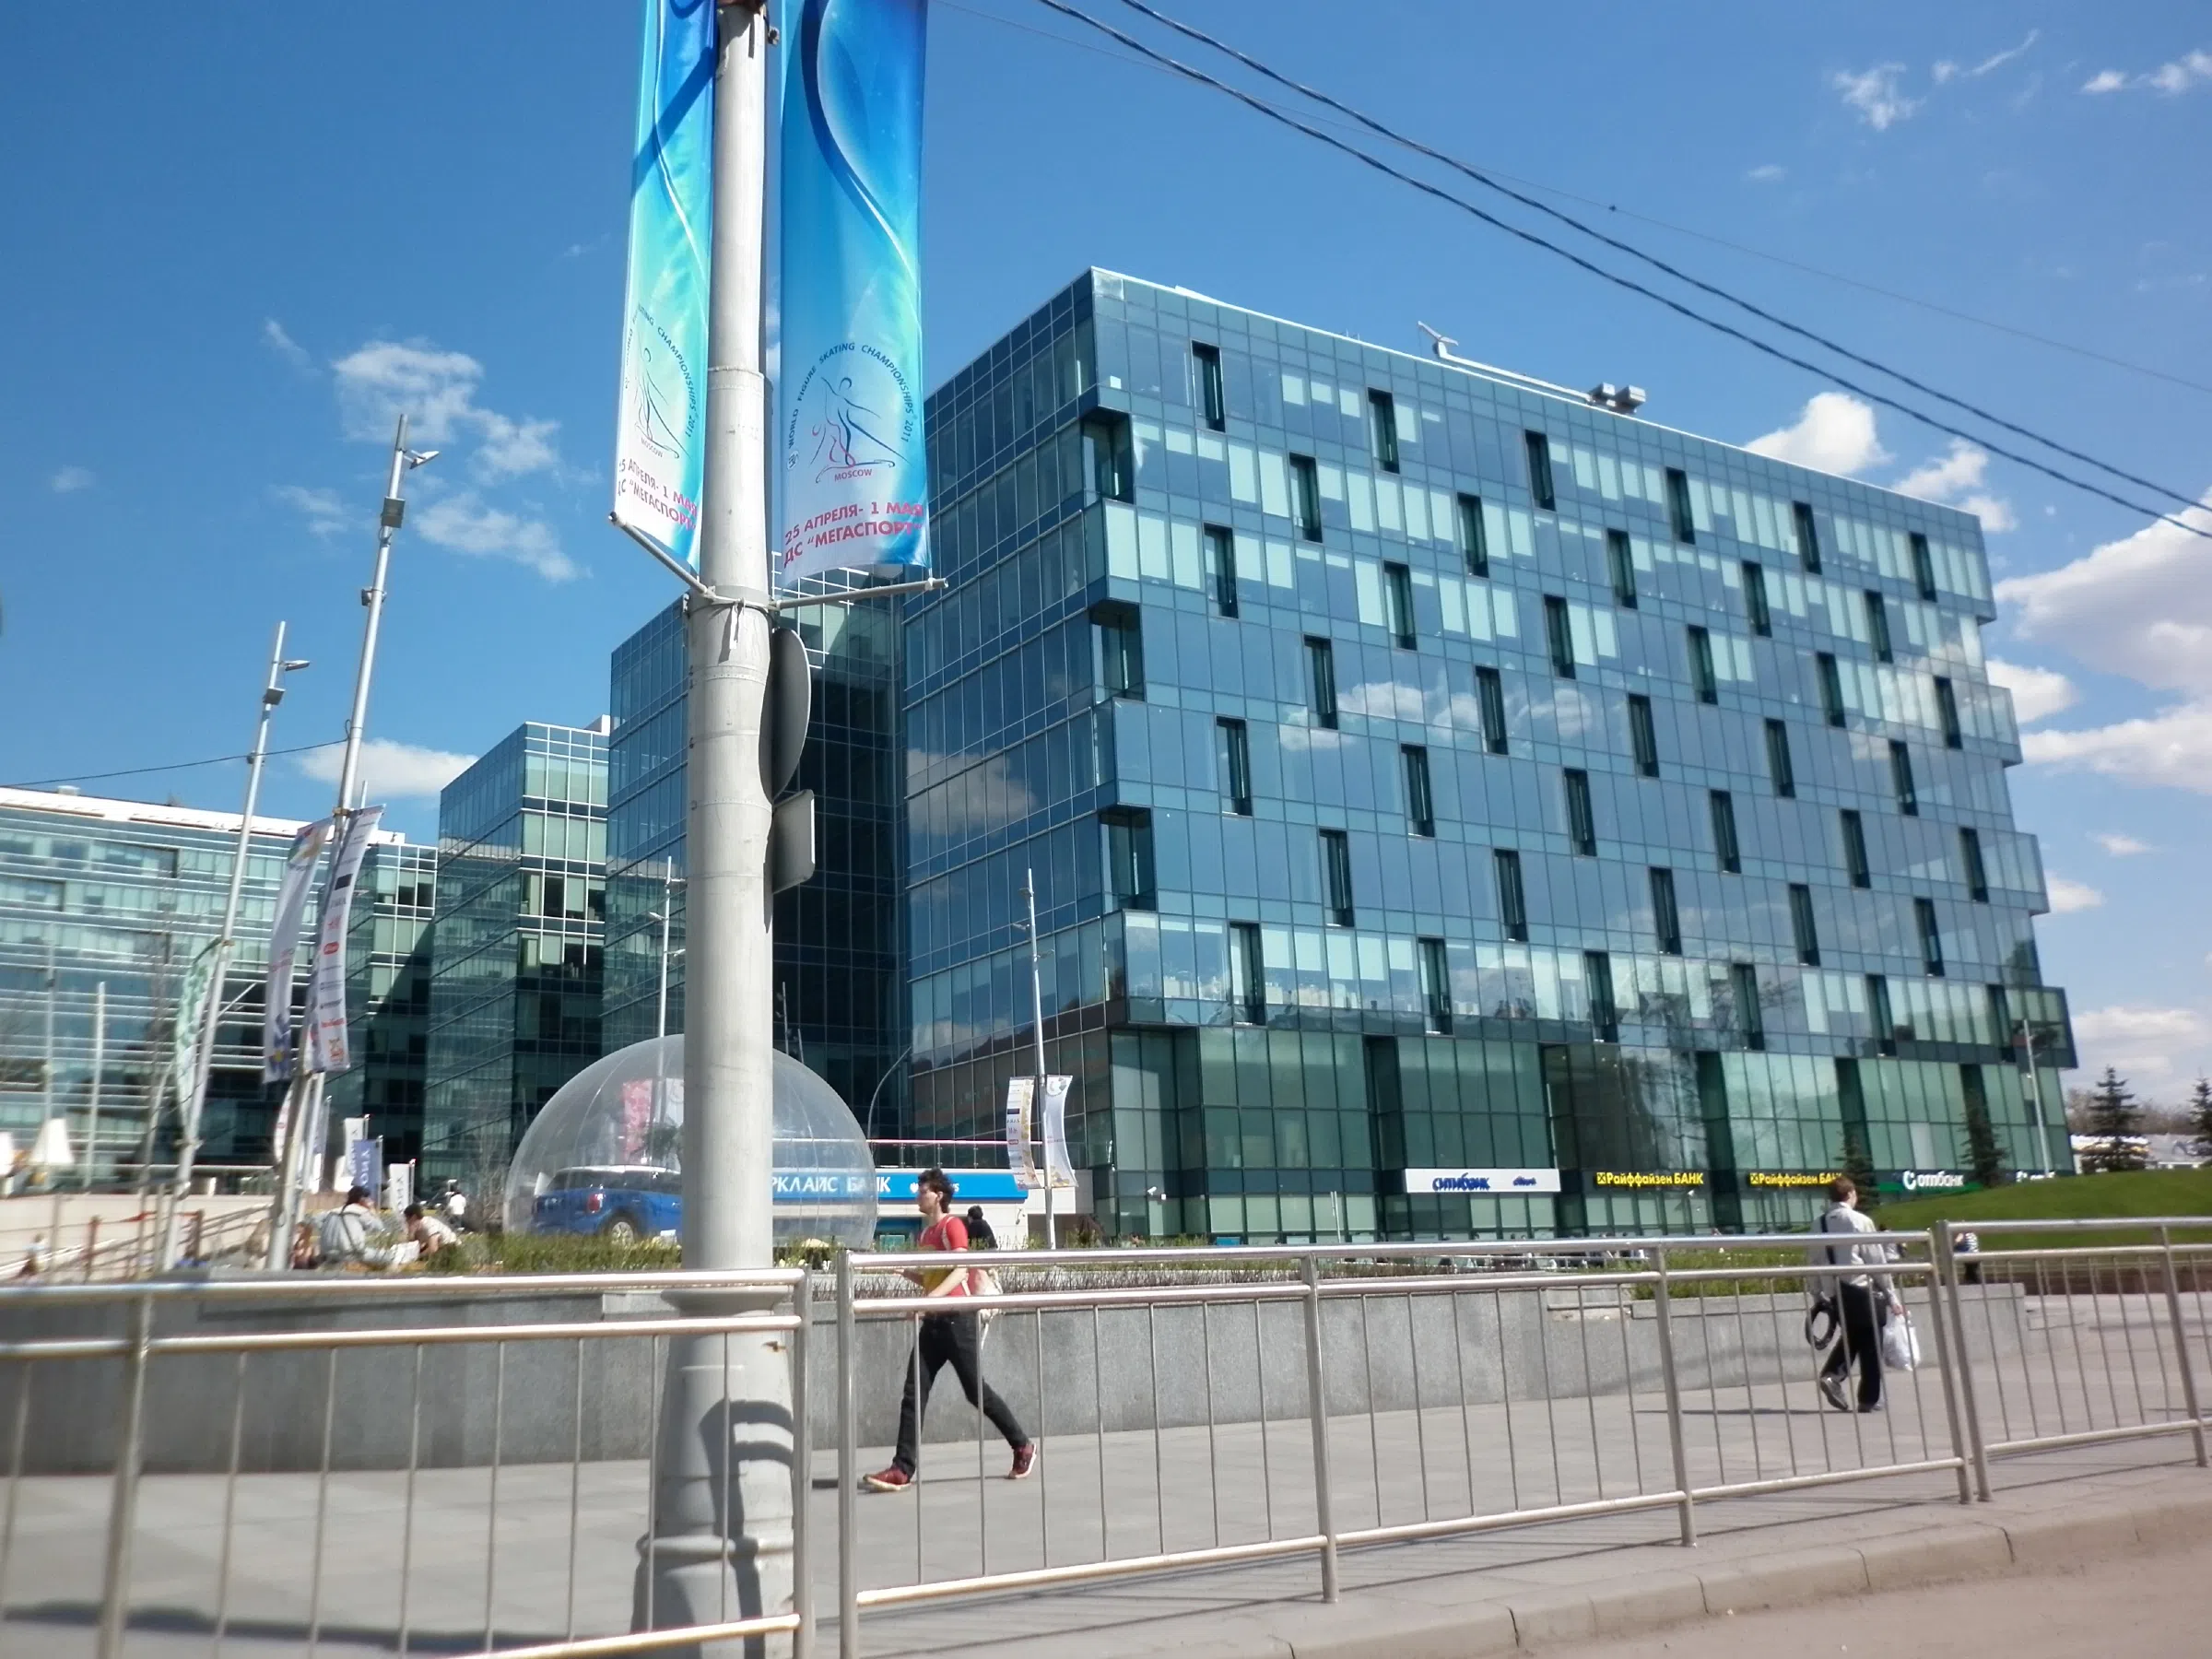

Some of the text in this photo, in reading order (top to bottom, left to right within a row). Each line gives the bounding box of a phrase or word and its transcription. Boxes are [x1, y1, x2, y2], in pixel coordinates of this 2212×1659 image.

[657, 326, 697, 413] CHAMPIONSHIPS
[788, 342, 914, 449] WORLD FIGURE SKATING CHAMPIONSHIPS 2011
[834, 468, 873, 482] MOSCOW
[673, 490, 698, 517] МАЯ
[784, 524, 800, 546] 25
[871, 501, 879, 515] 1
[886, 501, 924, 517] МАЯ
[783, 541, 804, 569] ДС
[1606, 1171, 1704, 1187] Райффайзен БАНК
[1759, 1172, 1818, 1187] Райффайзен
